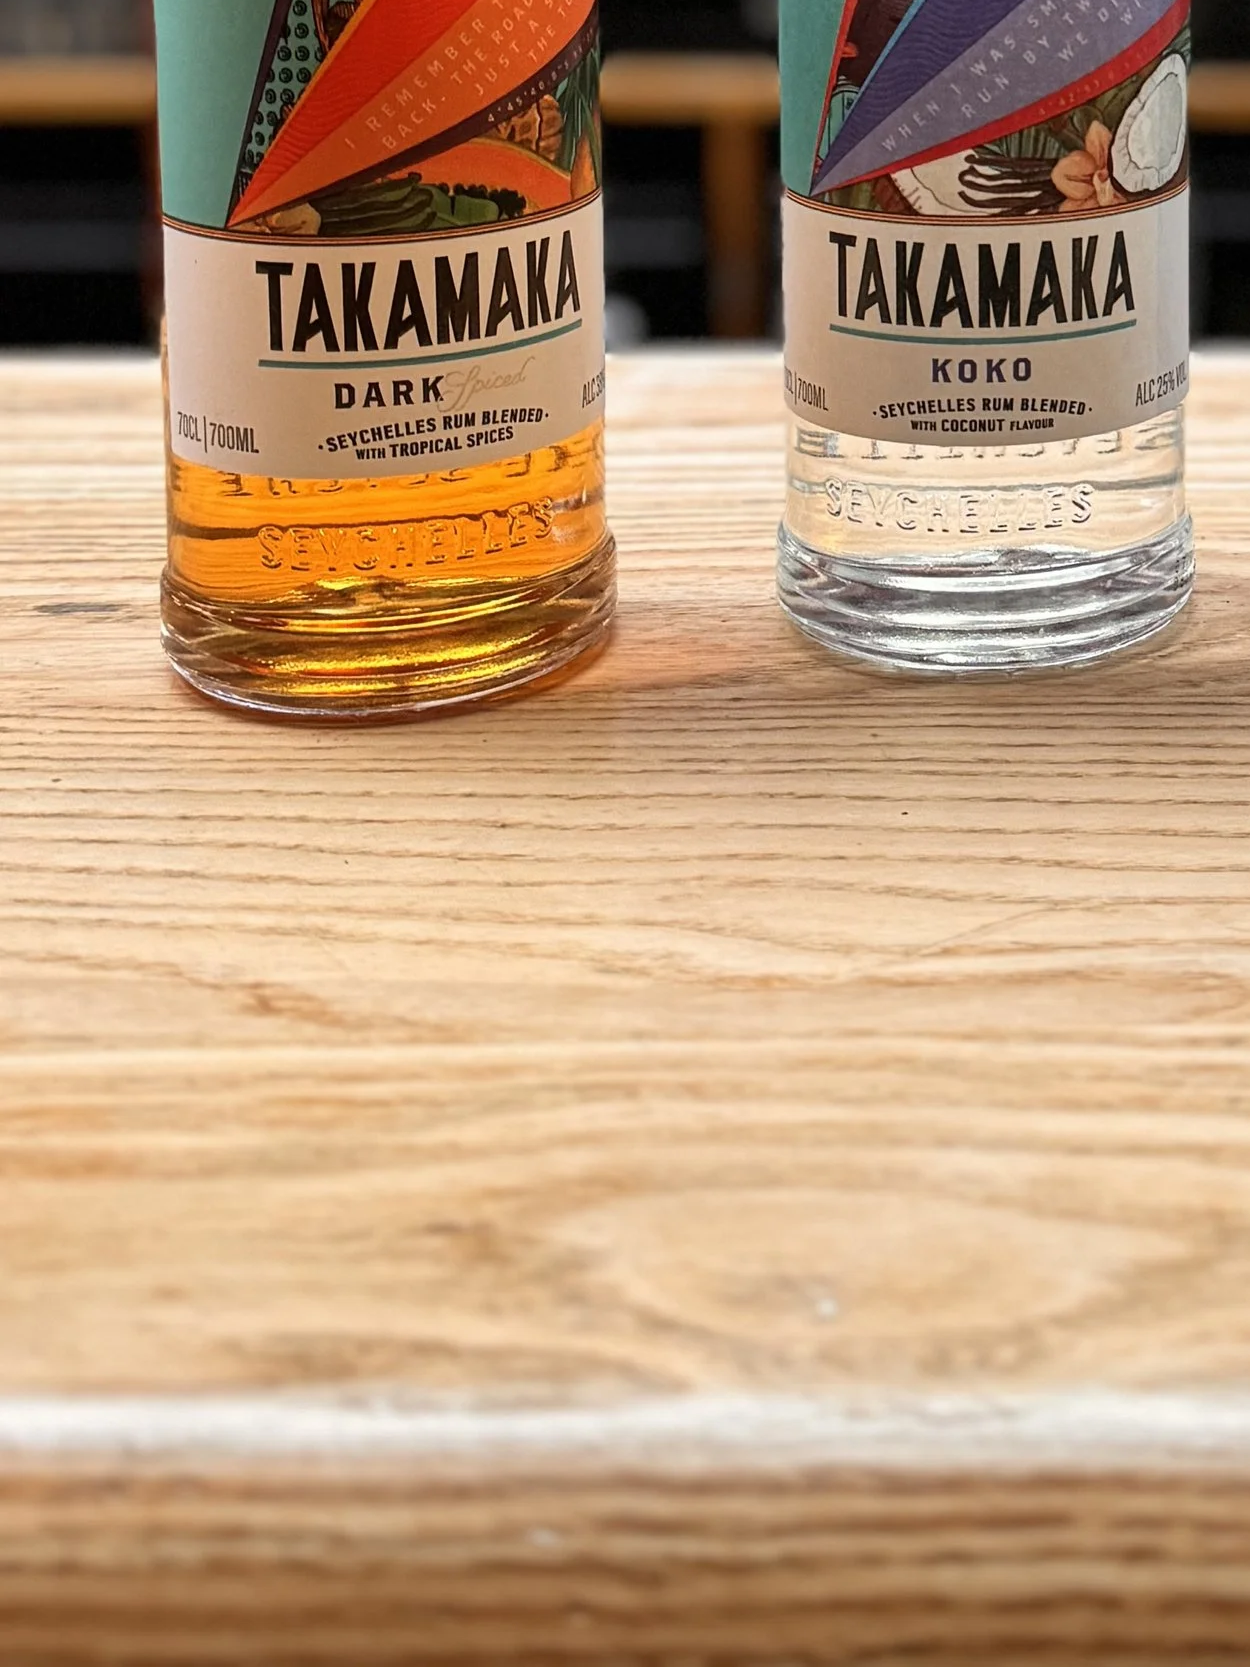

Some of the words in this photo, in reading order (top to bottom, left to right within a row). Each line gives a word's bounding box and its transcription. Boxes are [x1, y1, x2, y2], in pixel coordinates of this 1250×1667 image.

[527, 25, 555, 63] THE
[1058, 31, 1089, 63] WE
[365, 18, 485, 131] REMEMBER
[450, 49, 488, 86] THE
[474, 42, 521, 96] JUST
[961, 75, 1010, 118] RUN
[1023, 36, 1050, 64] BY
[882, 101, 941, 152] WHEN
[969, 34, 1016, 76] WAS
[256, 229, 581, 353] TAKAMAKA
[829, 231, 1137, 329] TAKAMAKA
[931, 356, 1033, 384] KOKO
[334, 375, 445, 409] DARK
[879, 397, 976, 420] SEYCHELLES
[981, 397, 1015, 413] RUM
[1020, 397, 1087, 417] BLENDED
[1135, 378, 1155, 407] ALC
[326, 417, 437, 453] SEYCHELLES
[442, 412, 476, 431] RUM
[481, 408, 544, 425] BLENDED
[356, 447, 386, 461] WITH
[389, 437, 462, 458] TROPICAL
[466, 425, 514, 449] SPICES
[910, 419, 938, 432] WITH
[941, 417, 1006, 433] COCONUT
[1009, 417, 1055, 431] FLAVOUR
[824, 477, 1096, 533] SEYCHELLES
[258, 497, 555, 572] SEYCHELLES
